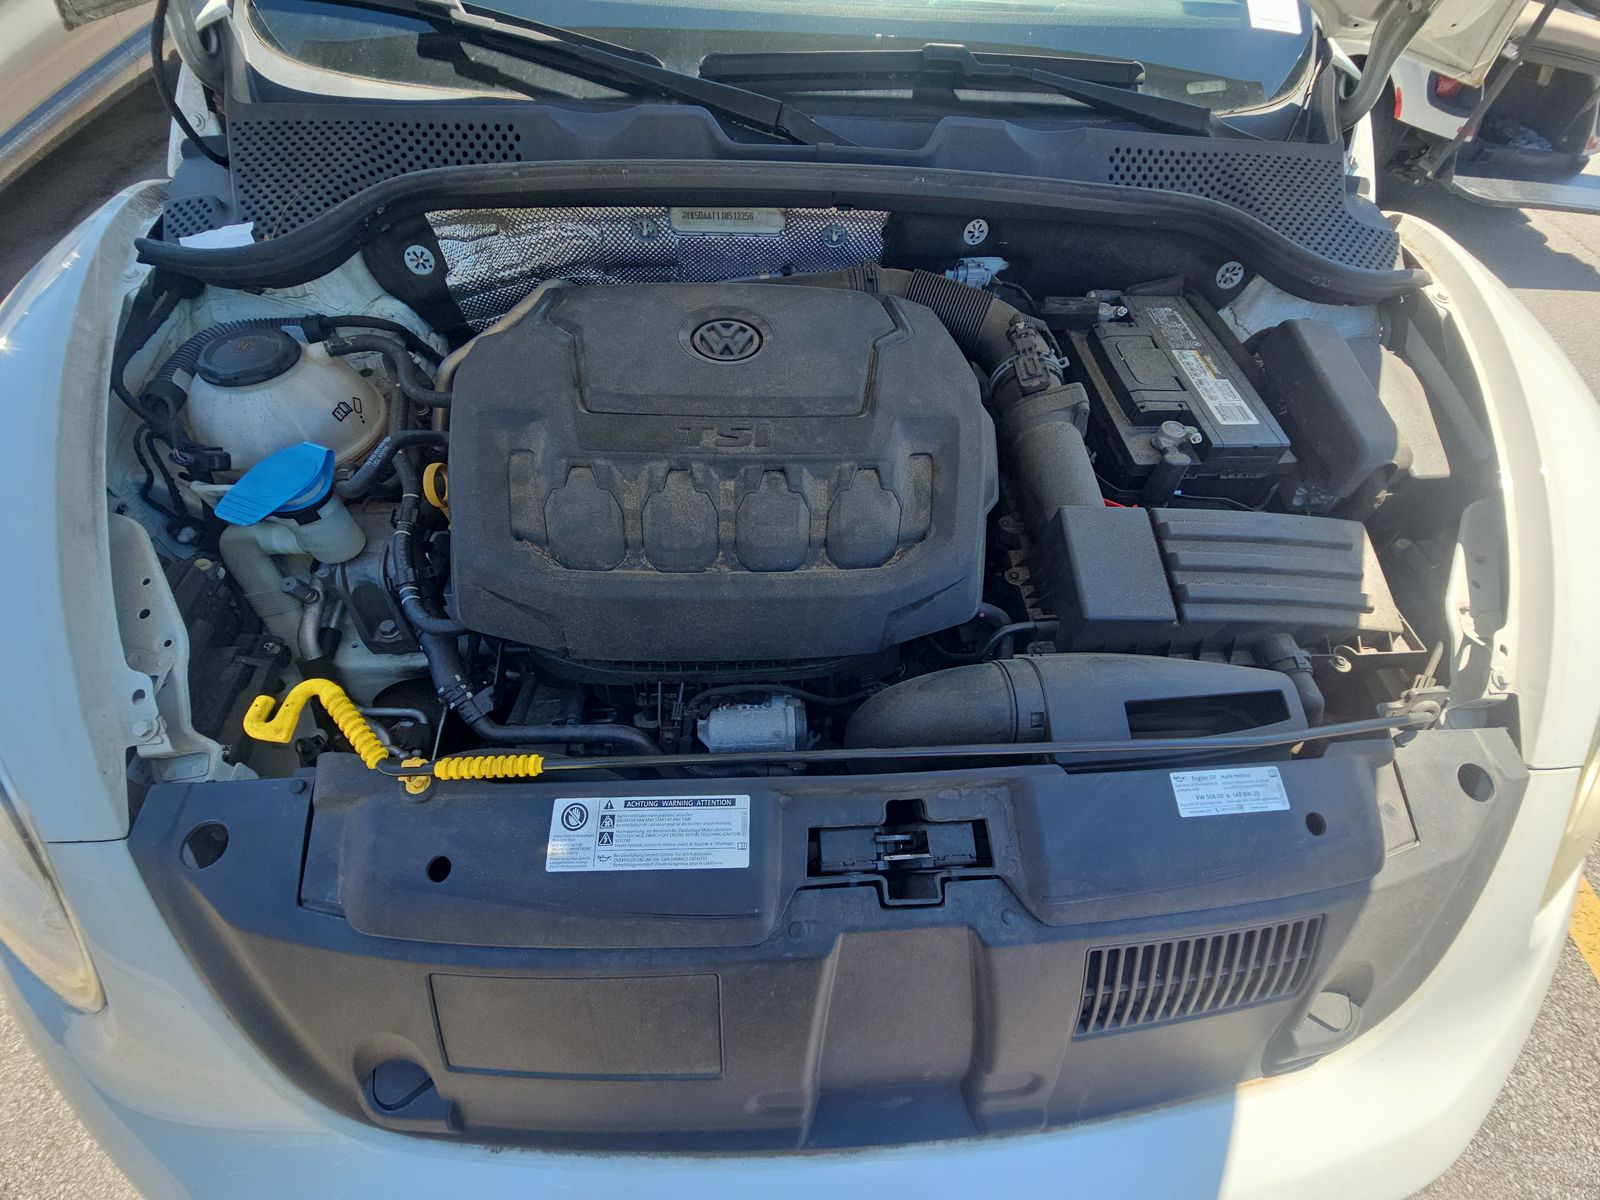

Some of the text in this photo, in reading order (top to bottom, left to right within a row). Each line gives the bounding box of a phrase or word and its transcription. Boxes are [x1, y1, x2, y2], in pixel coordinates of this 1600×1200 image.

[678, 424, 772, 449] TSI
[626, 800, 659, 808] ACHTUNG
[661, 799, 693, 807] WARNING
